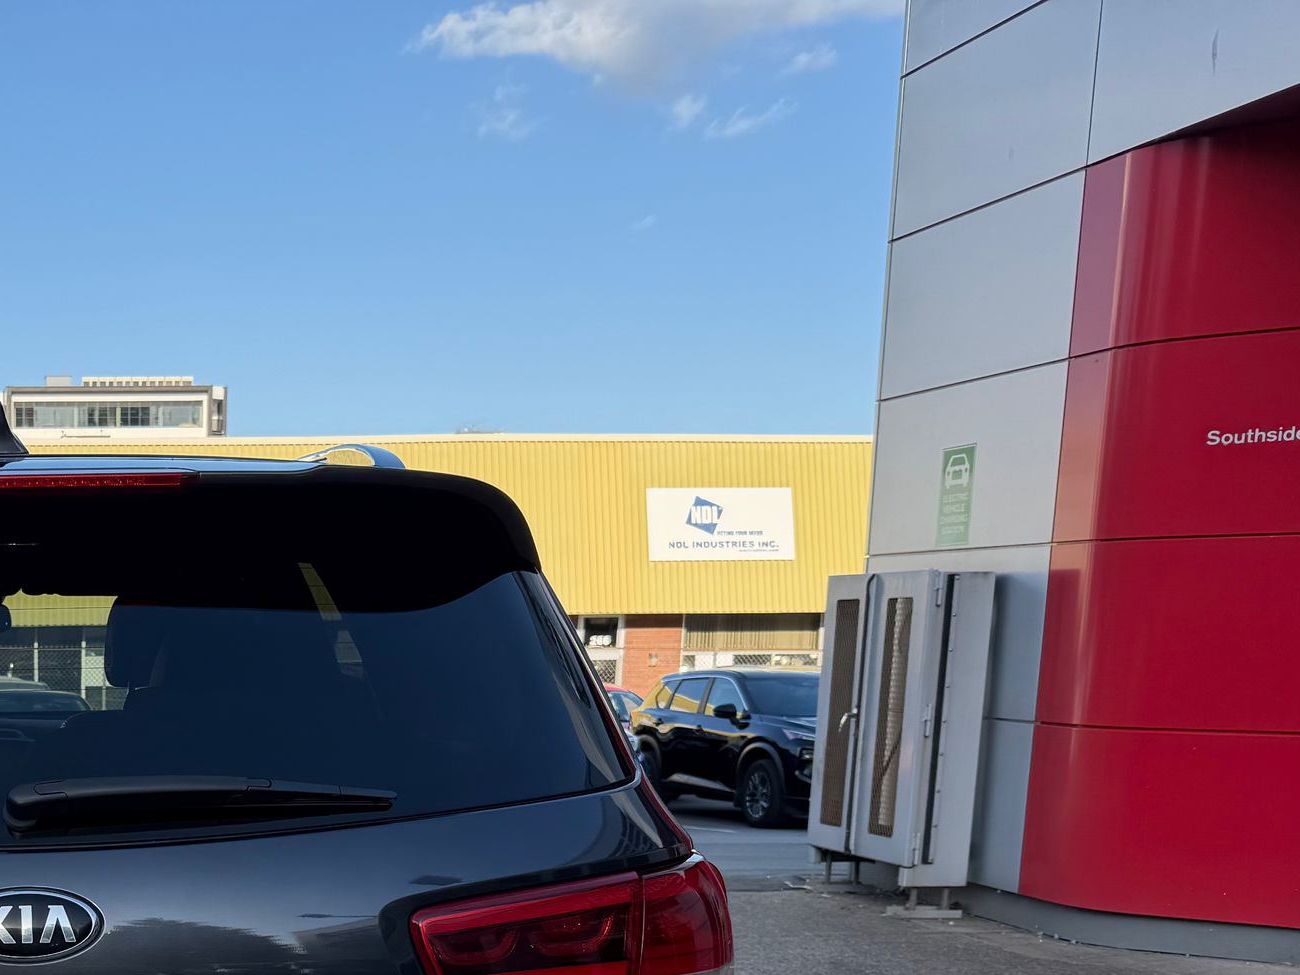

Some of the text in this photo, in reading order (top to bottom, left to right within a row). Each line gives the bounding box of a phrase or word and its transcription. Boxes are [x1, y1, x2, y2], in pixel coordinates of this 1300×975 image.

[691, 506, 719, 524] NDL
[668, 541, 689, 549] NDL
[692, 540, 755, 549] INDUSTRIES
